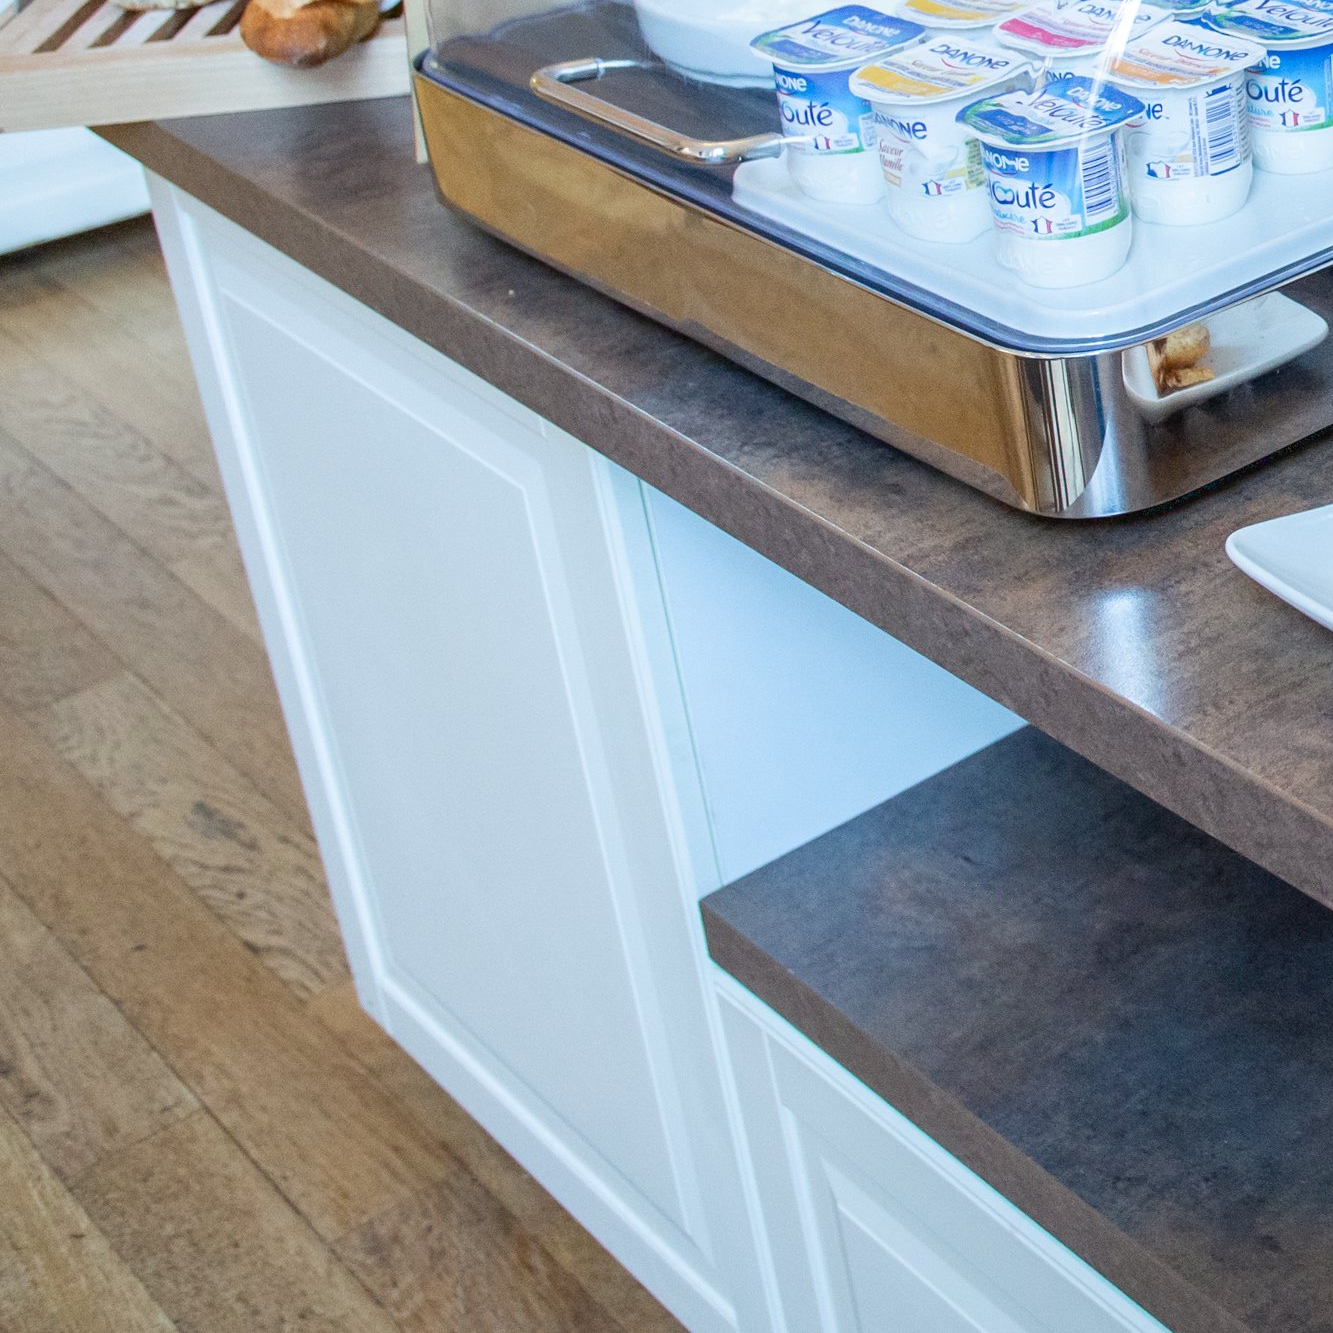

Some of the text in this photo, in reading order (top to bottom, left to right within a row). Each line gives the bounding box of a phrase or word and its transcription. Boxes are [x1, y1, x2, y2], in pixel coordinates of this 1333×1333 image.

[930, 44, 1010, 69] DANONE
[1162, 35, 1249, 62] DANONE
[776, 73, 807, 92] NONE
[1246, 77, 1304, 104] outé
[781, 100, 834, 127] outé
[982, 149, 1030, 173] NONE
[991, 181, 1057, 210] outé
